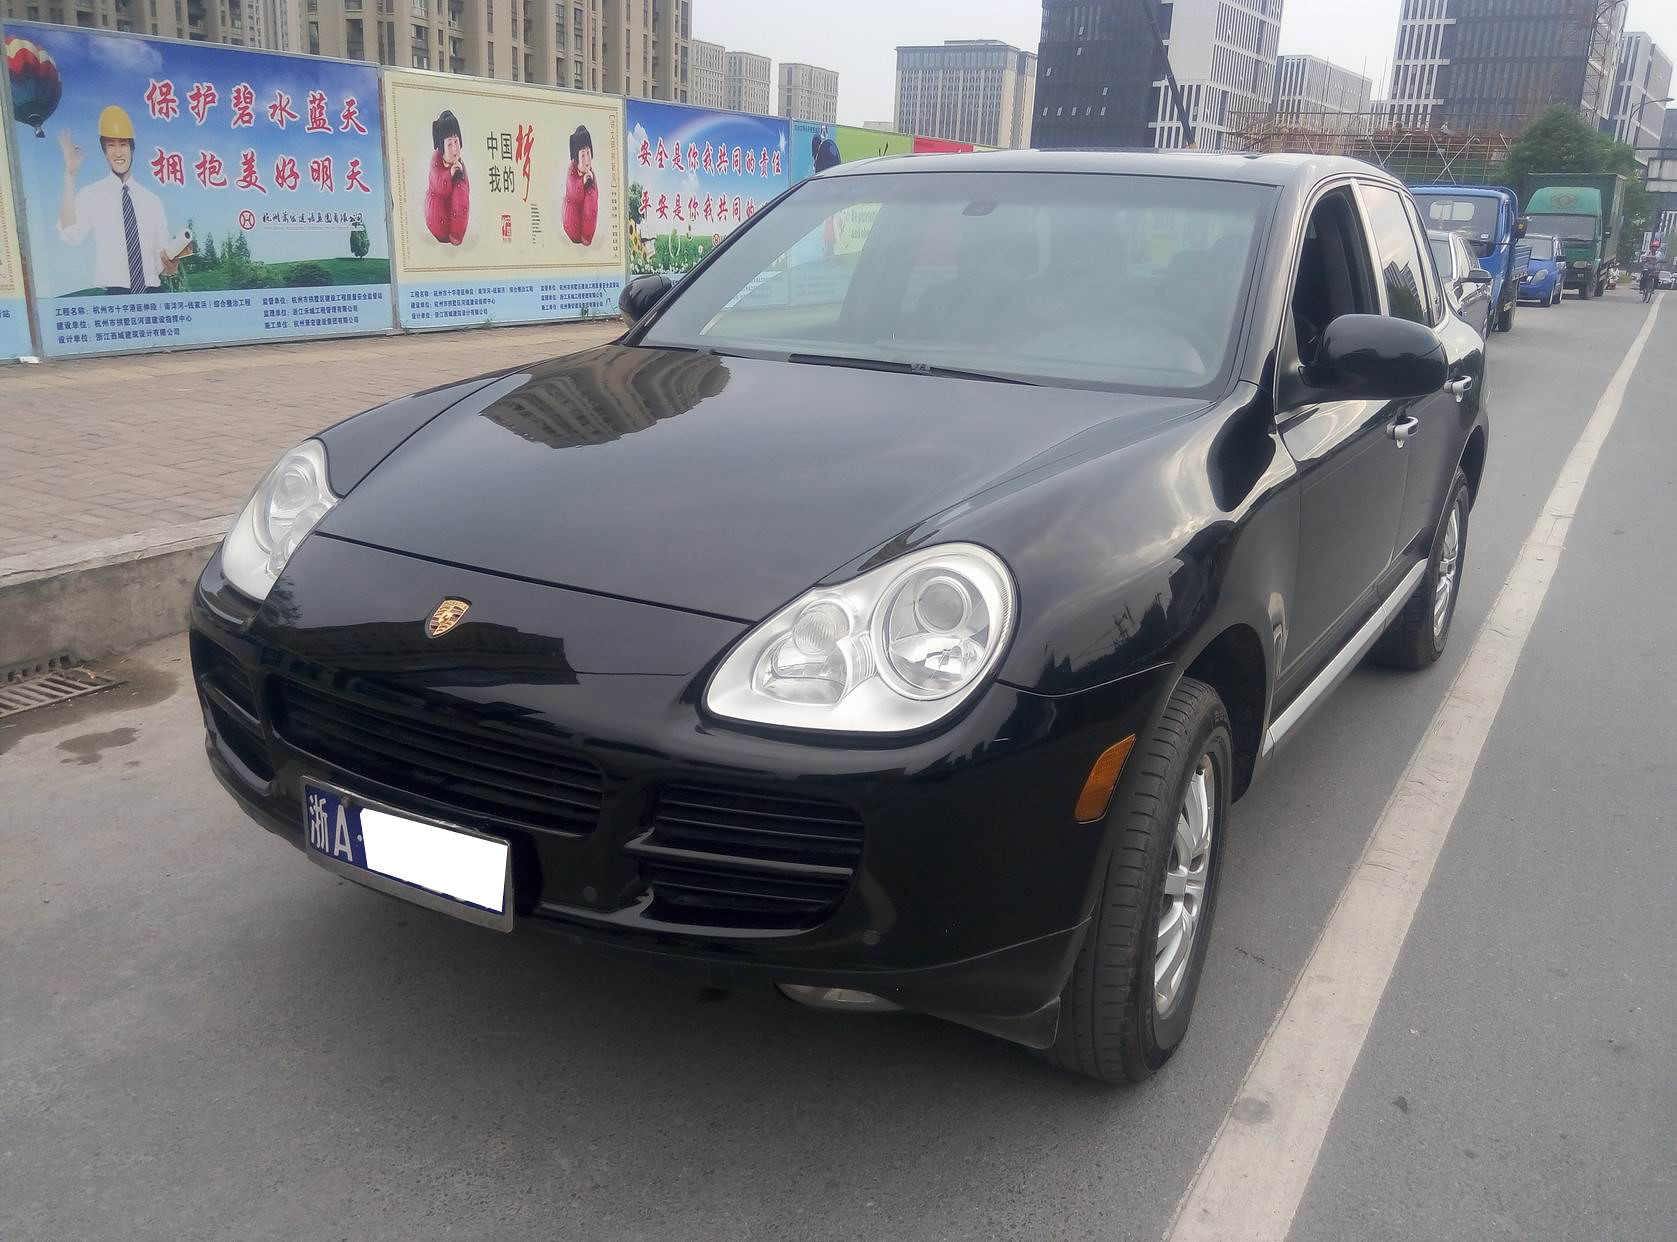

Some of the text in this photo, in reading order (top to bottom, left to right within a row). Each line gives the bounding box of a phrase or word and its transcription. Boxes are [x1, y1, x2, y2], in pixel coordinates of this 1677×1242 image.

[145, 80, 368, 134] 保护碧水蓝天
[486, 131, 513, 160] 中国
[637, 136, 782, 177] 安全是你我共同的责任
[150, 149, 371, 194] 拥抱美好明天
[488, 165, 515, 192] 我的
[638, 190, 769, 223] 平安是你我共同的
